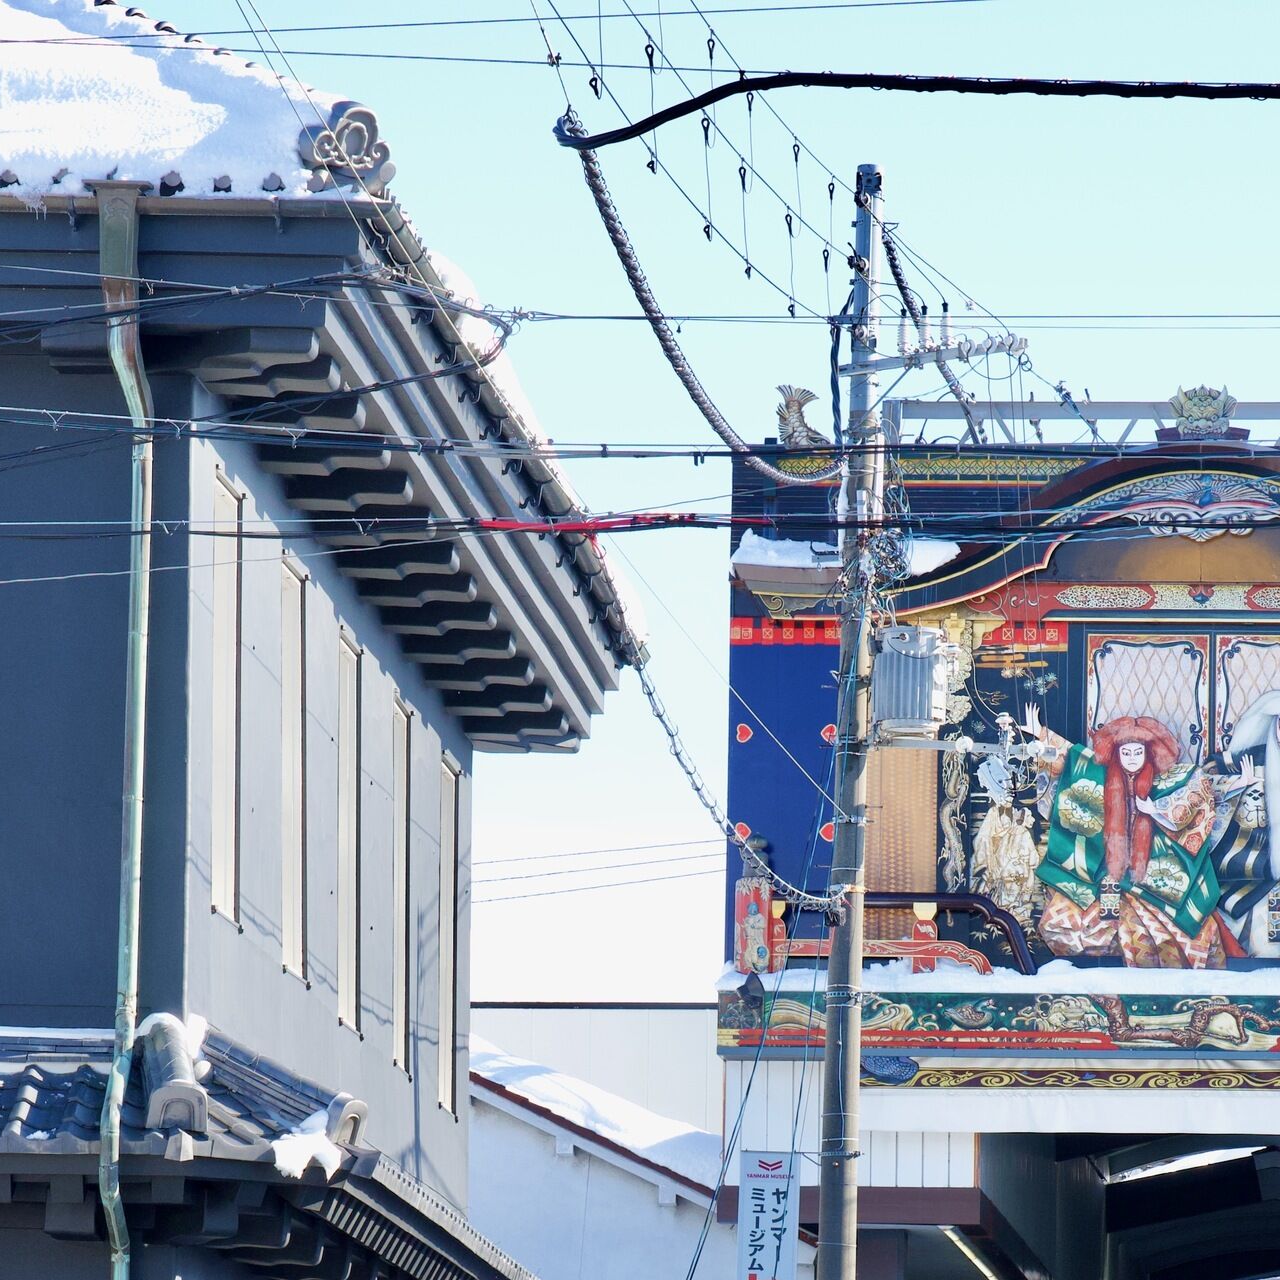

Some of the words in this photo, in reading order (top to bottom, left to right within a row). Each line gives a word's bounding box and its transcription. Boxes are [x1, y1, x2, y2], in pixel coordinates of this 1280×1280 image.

[748, 1187, 766, 1271] ミュージアム
[771, 1188, 788, 1262] ヤンマー
